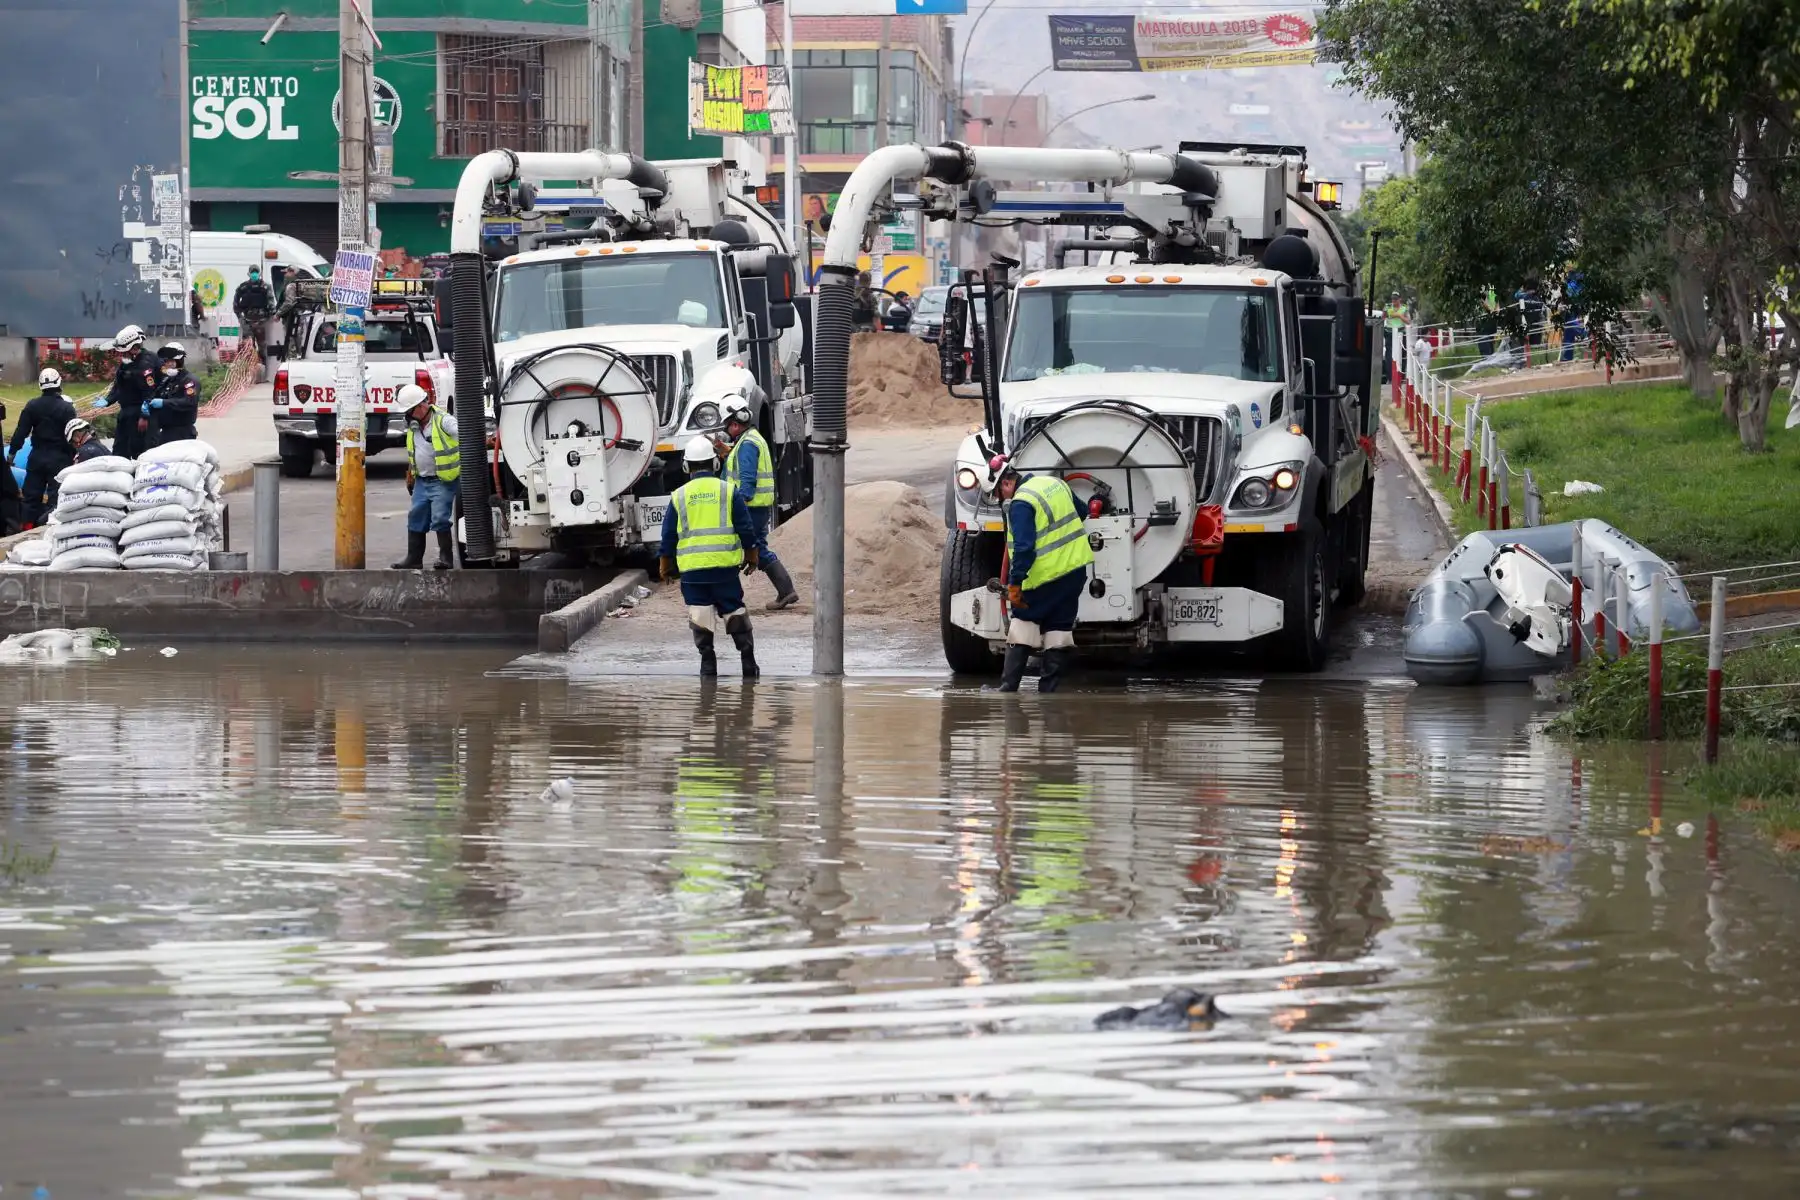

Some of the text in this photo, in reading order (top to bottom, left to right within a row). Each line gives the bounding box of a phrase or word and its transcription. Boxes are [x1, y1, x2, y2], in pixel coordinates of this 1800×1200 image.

[1137, 18, 1257, 36] MATRÍCULA 2019
[1087, 36, 1127, 46] SCHOOL
[193, 76, 299, 97] CEMENTO
[193, 96, 299, 140] SOL
[335, 251, 373, 271] PIURANO
[312, 387, 394, 404] RETE
[689, 490, 716, 500] sedapal
